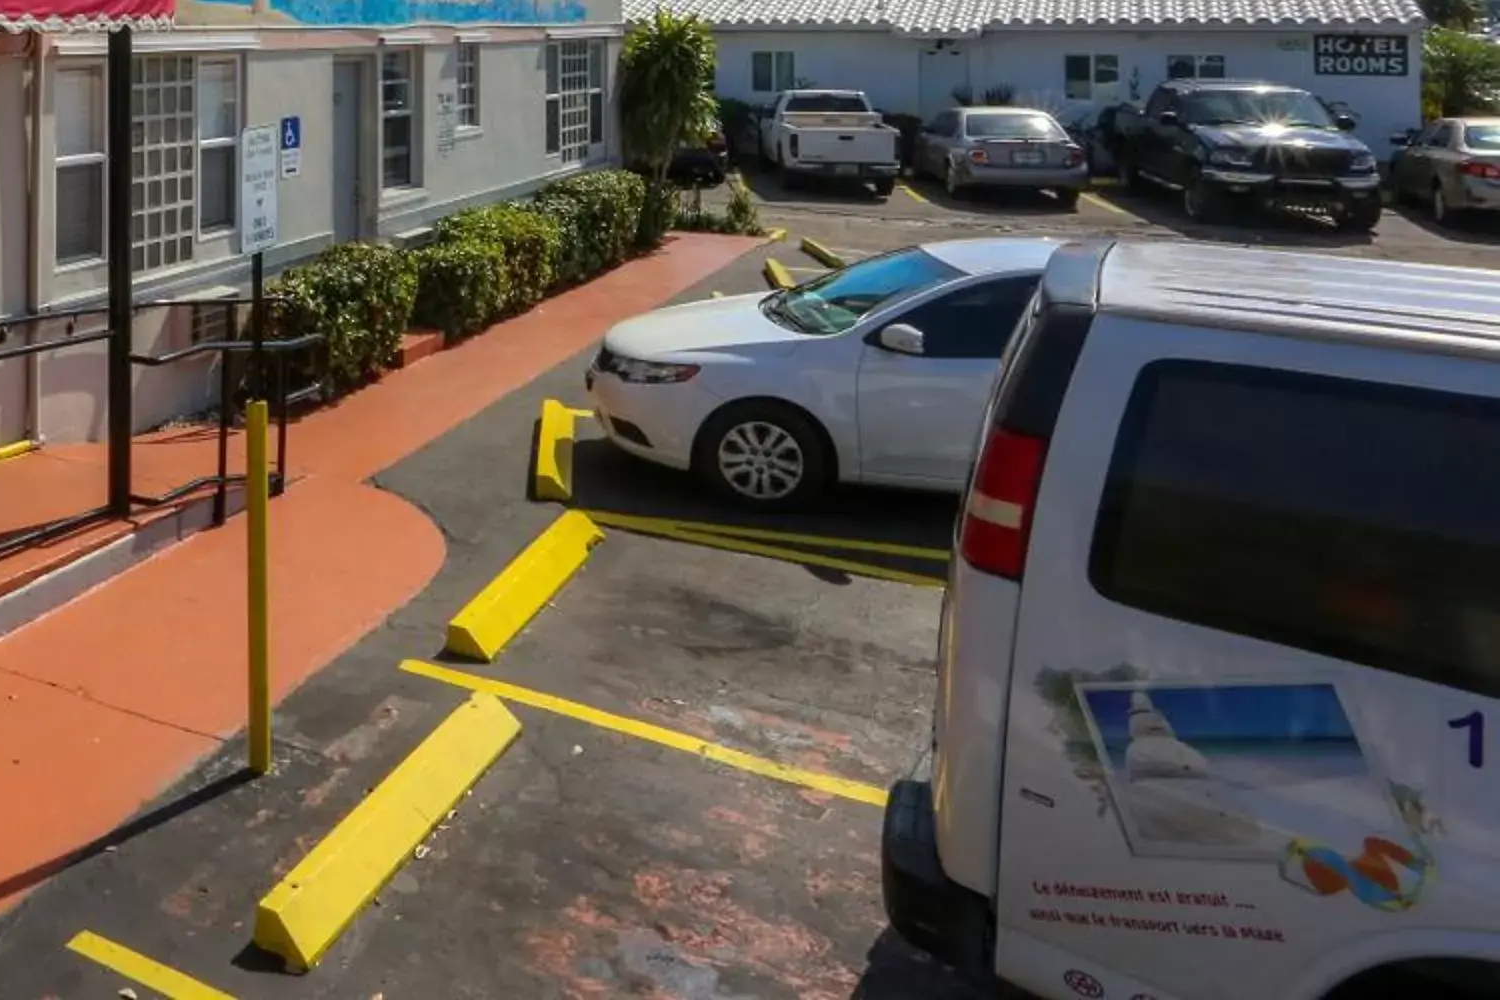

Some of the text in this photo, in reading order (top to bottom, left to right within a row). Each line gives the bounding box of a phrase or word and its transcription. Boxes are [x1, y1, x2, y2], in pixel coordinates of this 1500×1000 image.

[1318, 56, 1404, 74] ROOMS
[1446, 709, 1485, 769] 1
[1109, 912, 1180, 935] transport
